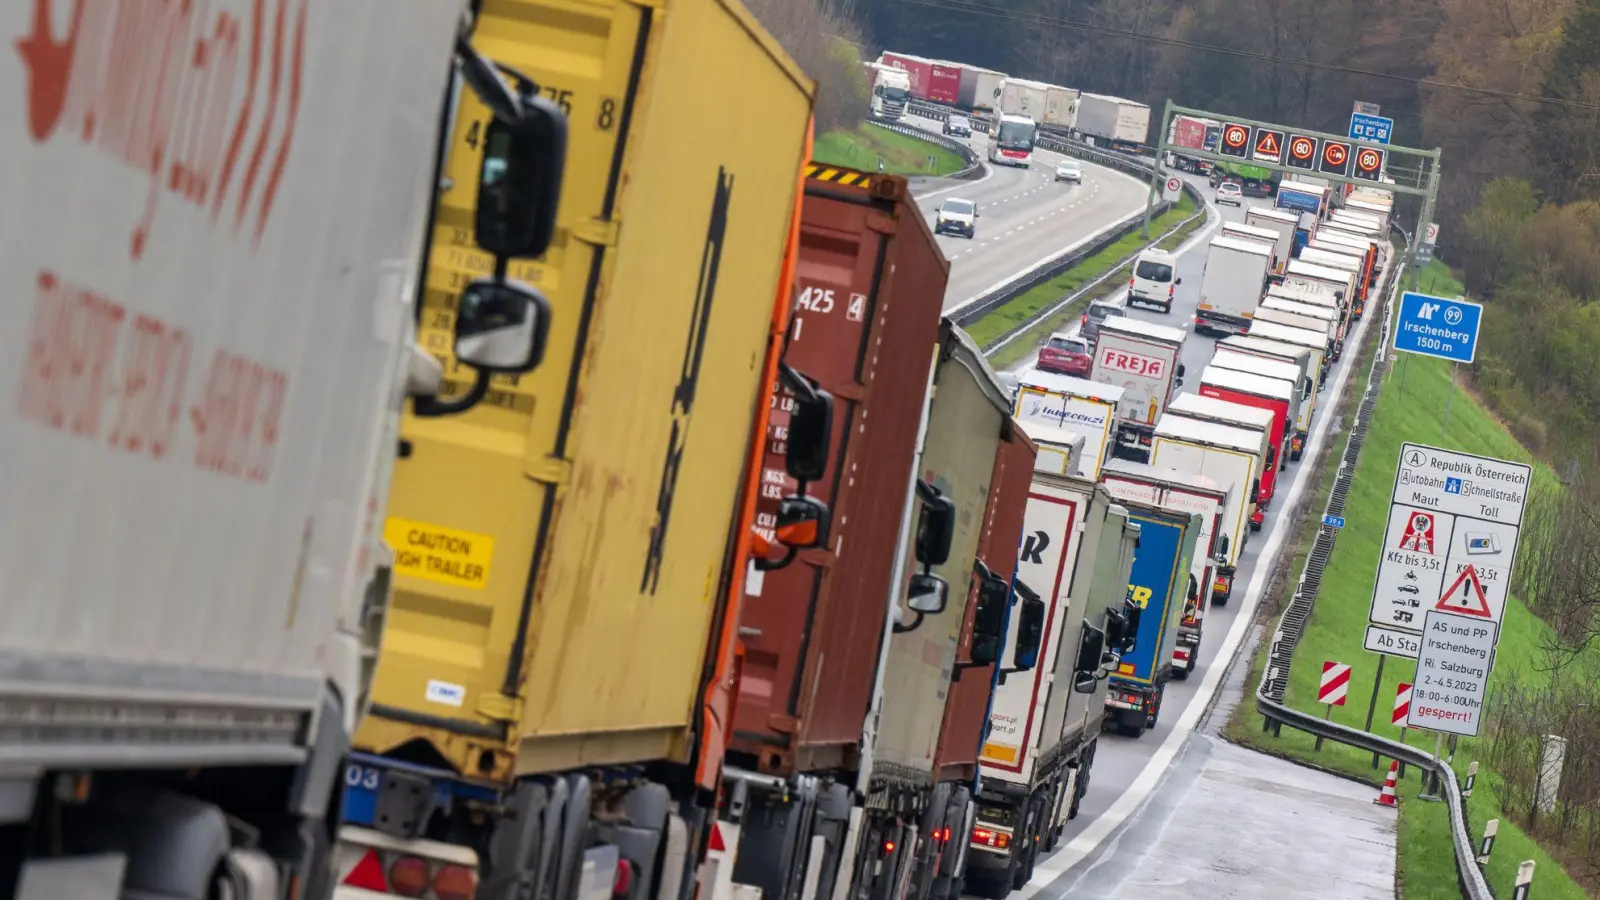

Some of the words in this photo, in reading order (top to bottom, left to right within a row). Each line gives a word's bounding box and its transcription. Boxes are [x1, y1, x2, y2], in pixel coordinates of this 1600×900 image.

[598, 97, 615, 131] 8
[1229, 132, 1243, 142] 80
[1295, 143, 1309, 155] 80
[1363, 154, 1376, 166] 80
[849, 296, 865, 320] 4
[1447, 310, 1460, 321] 99
[1404, 320, 1470, 344] Irschenberg
[1416, 336, 1441, 350] 1500
[1441, 343, 1453, 352] m
[1105, 352, 1161, 374] FREJA
[1410, 452, 1419, 465] A
[1430, 457, 1472, 475] Republik
[1475, 463, 1526, 484] Österreich
[1401, 470, 1444, 489] Autobahn
[1462, 481, 1521, 504] Schnellstraße
[1412, 492, 1439, 506] Maut
[1480, 505, 1499, 518] Toll
[407, 528, 471, 557] CAUTION
[426, 555, 484, 581] TRAILER
[1387, 551, 1402, 564] Kfz
[1405, 555, 1419, 566] bis
[1421, 557, 1440, 571] 3,5t
[1432, 621, 1448, 633] AS
[1451, 625, 1470, 636] und
[1473, 628, 1488, 639] PP
[1377, 634, 1394, 647] Ab
[1396, 637, 1419, 652] Sta
[1428, 638, 1486, 660] Irschenberg
[1424, 658, 1436, 669] Ri.
[1440, 661, 1484, 679] Salzburg
[1418, 706, 1472, 723] gesperrt!
[345, 764, 379, 790] 03
